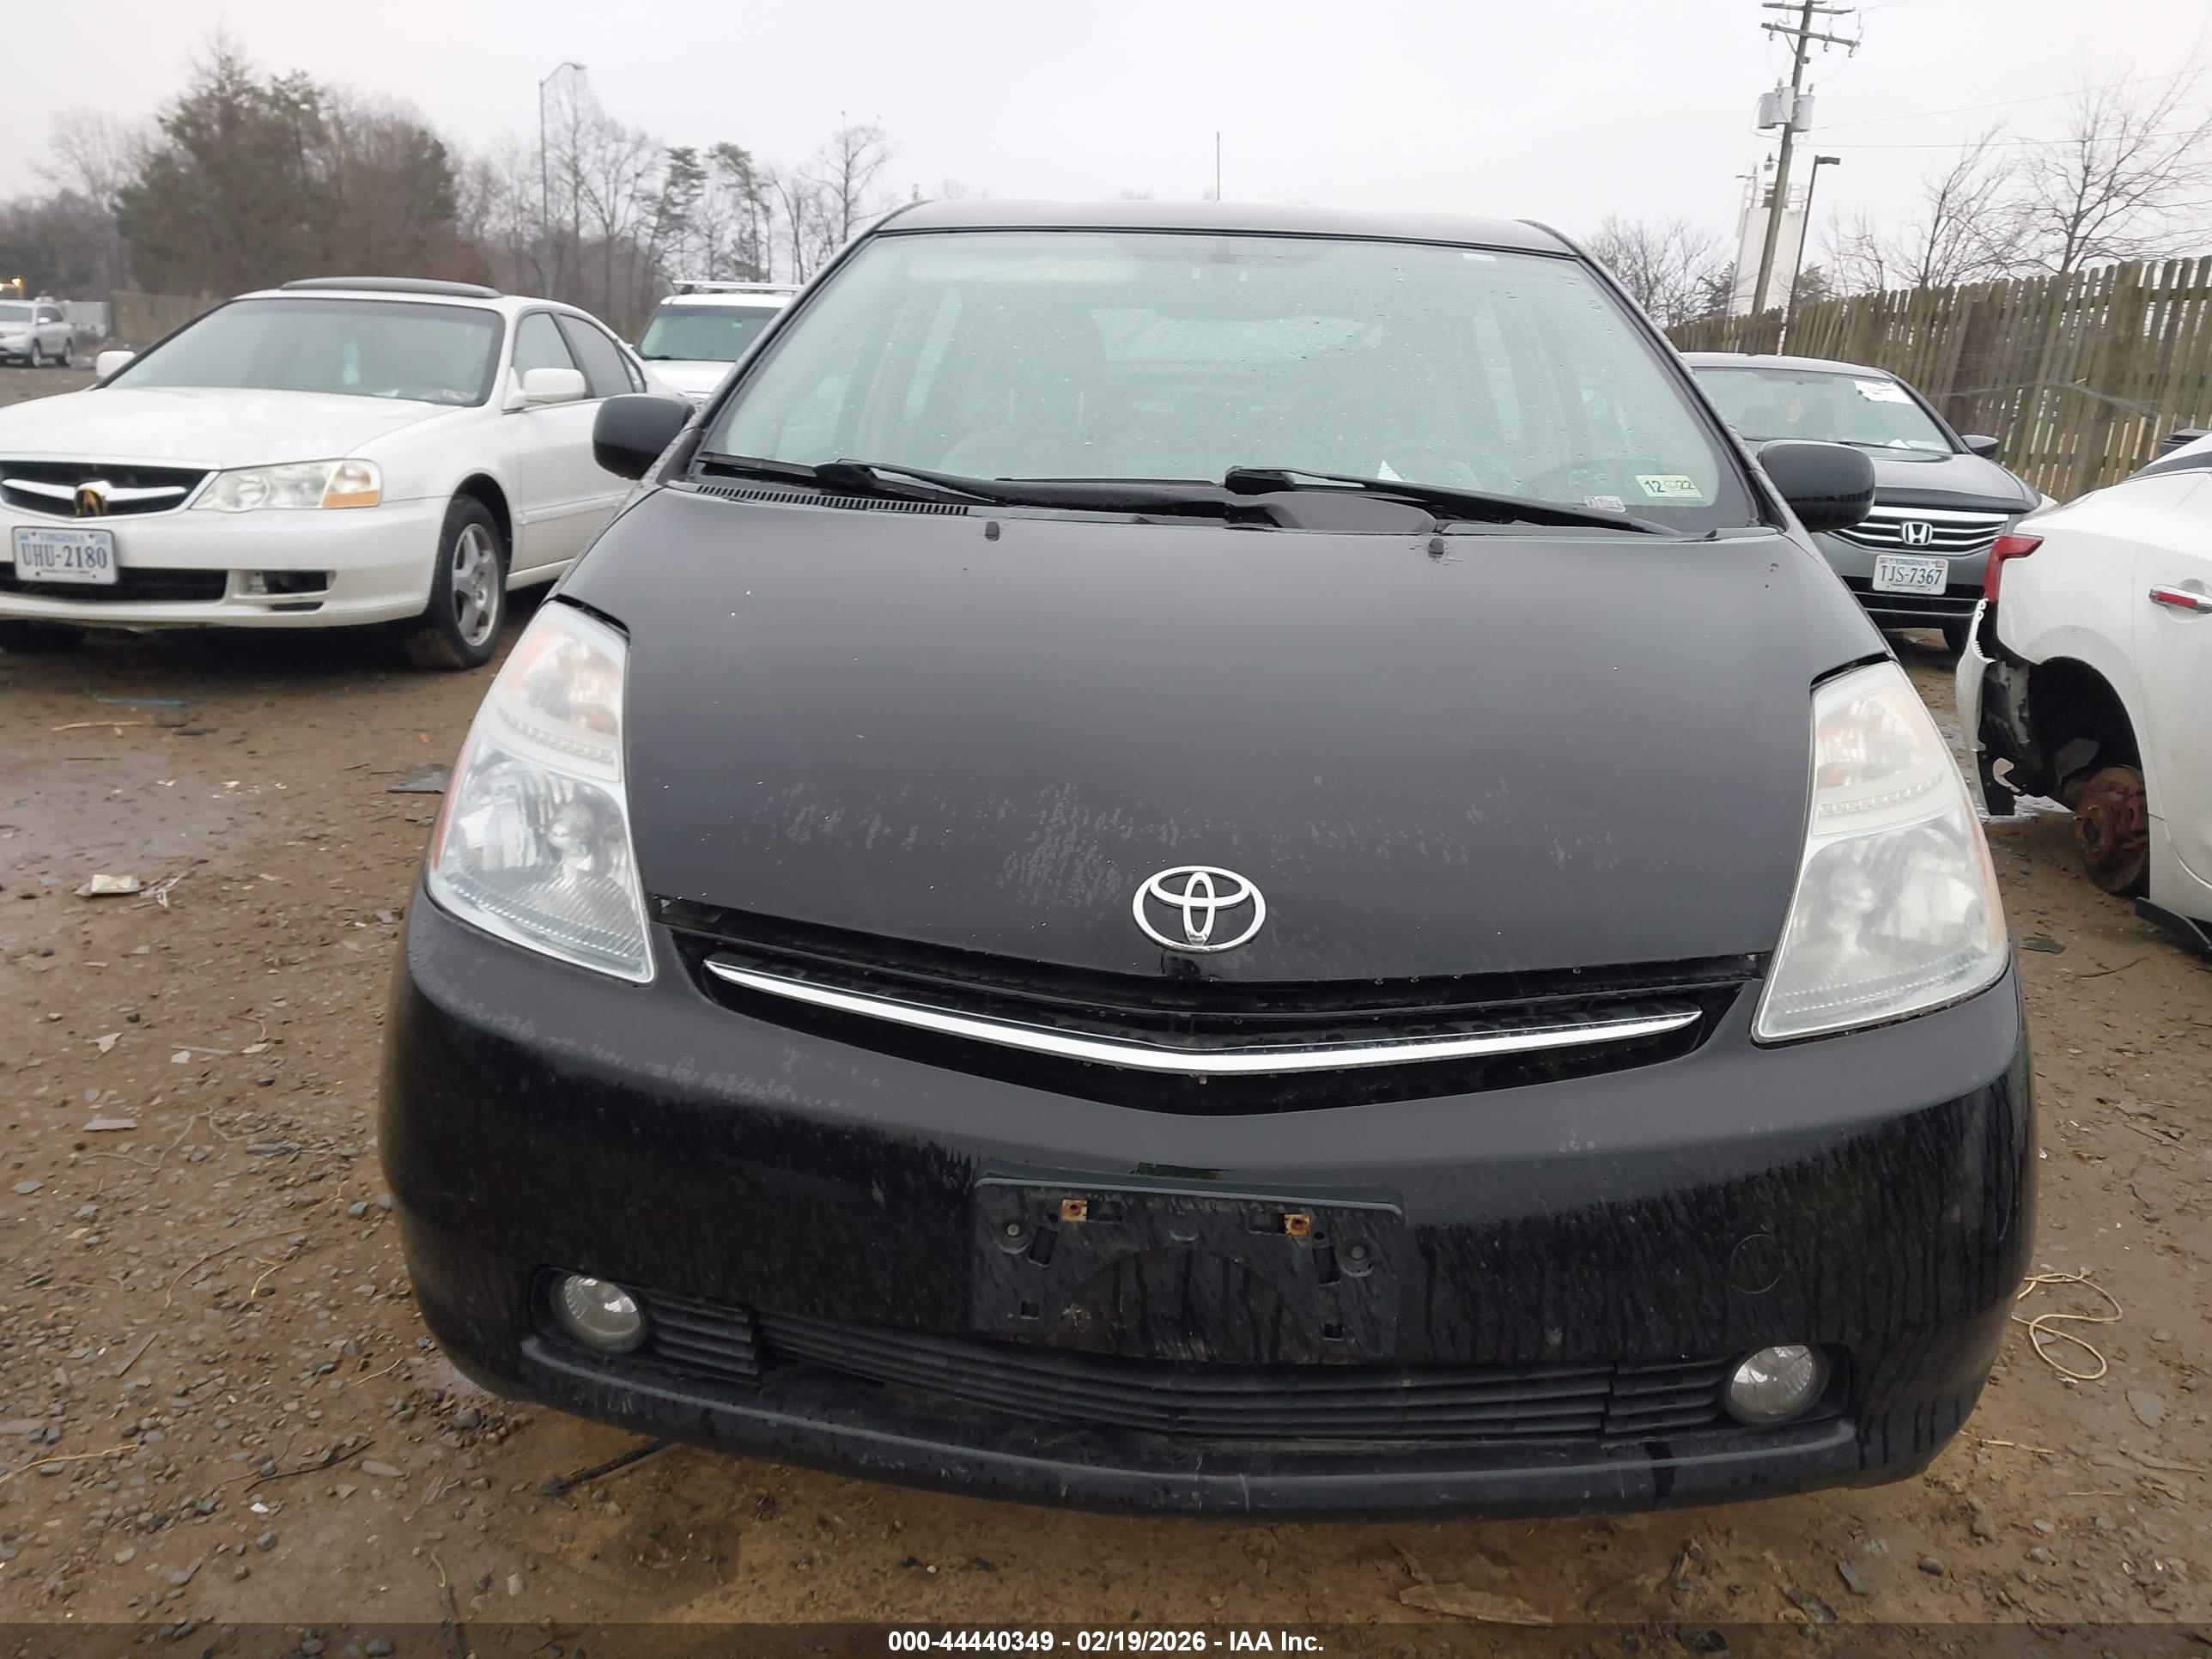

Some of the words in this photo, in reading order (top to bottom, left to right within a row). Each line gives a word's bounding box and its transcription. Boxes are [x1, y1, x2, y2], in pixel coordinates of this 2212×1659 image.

[1644, 480, 1666, 493] 12
[1676, 480, 1695, 489] 22
[21, 543, 108, 568] UHU-2180
[1881, 565, 1943, 585] TJS-7367
